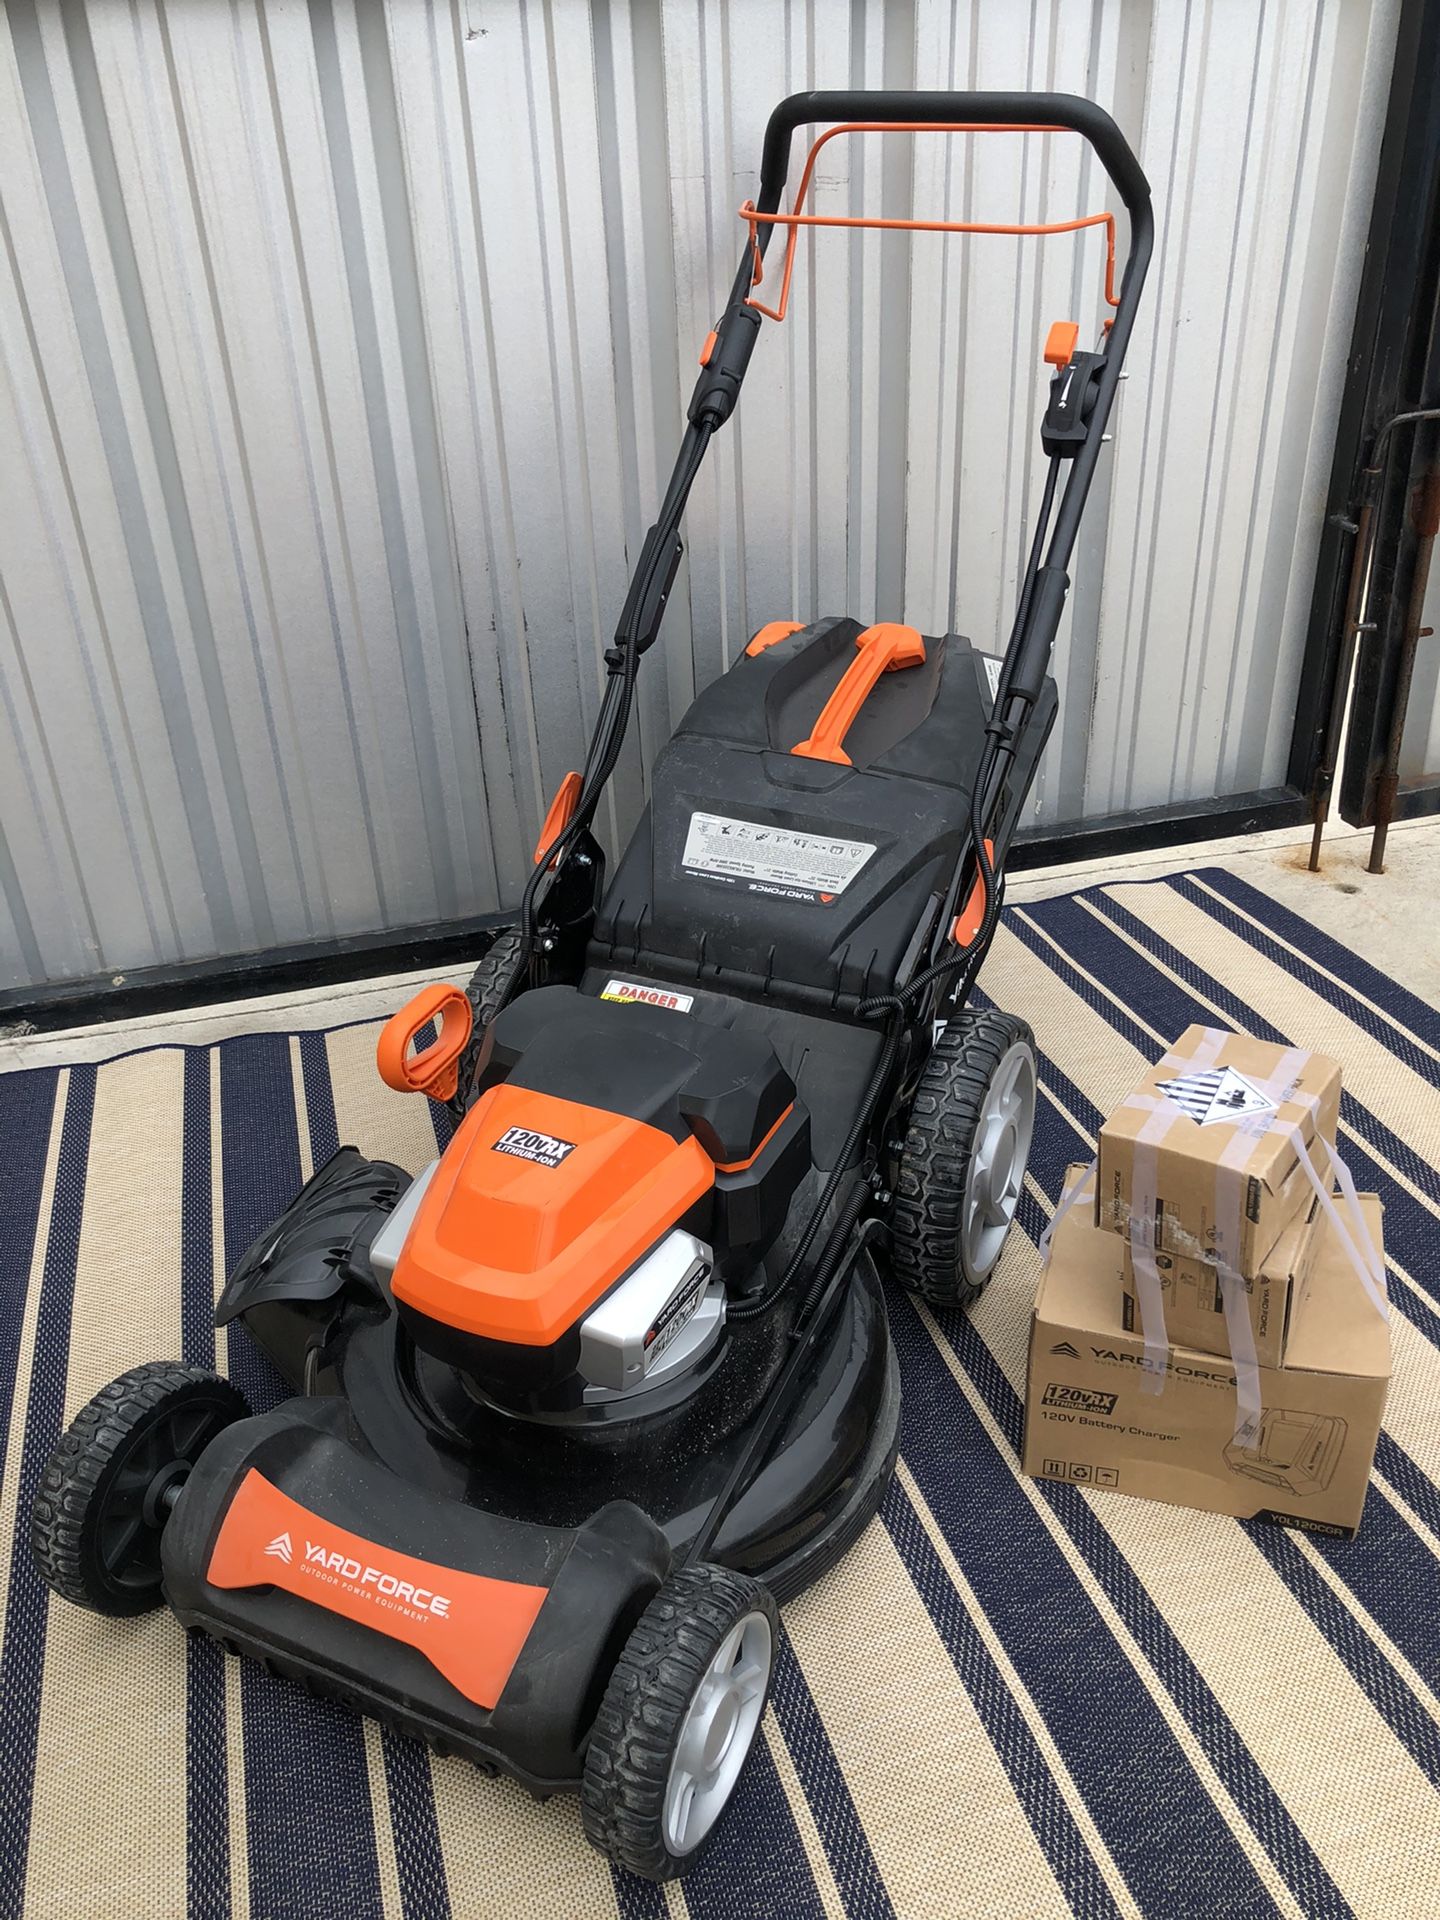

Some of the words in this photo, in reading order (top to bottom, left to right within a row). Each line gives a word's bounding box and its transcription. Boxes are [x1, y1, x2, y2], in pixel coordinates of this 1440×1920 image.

[748, 883, 786, 896] FORCE
[786, 890, 815, 901] YARD
[618, 985, 678, 1009] DANGER
[495, 1143, 557, 1167] LITHIUM-ION
[1262, 1288, 1270, 1313] YARD
[1090, 1347, 1154, 1368] YARD
[1046, 1399, 1108, 1414] LITHIUM-ION
[1041, 1411, 1076, 1423] 120V
[1079, 1417, 1126, 1433] Battery
[1129, 1427, 1180, 1441] Charger
[304, 1541, 362, 1580] YARD
[361, 1567, 451, 1618] FORCE
[300, 1563, 339, 1585] OUTDOOR
[341, 1580, 372, 1600] POWER
[375, 1597, 429, 1623] EQUIPMENT
